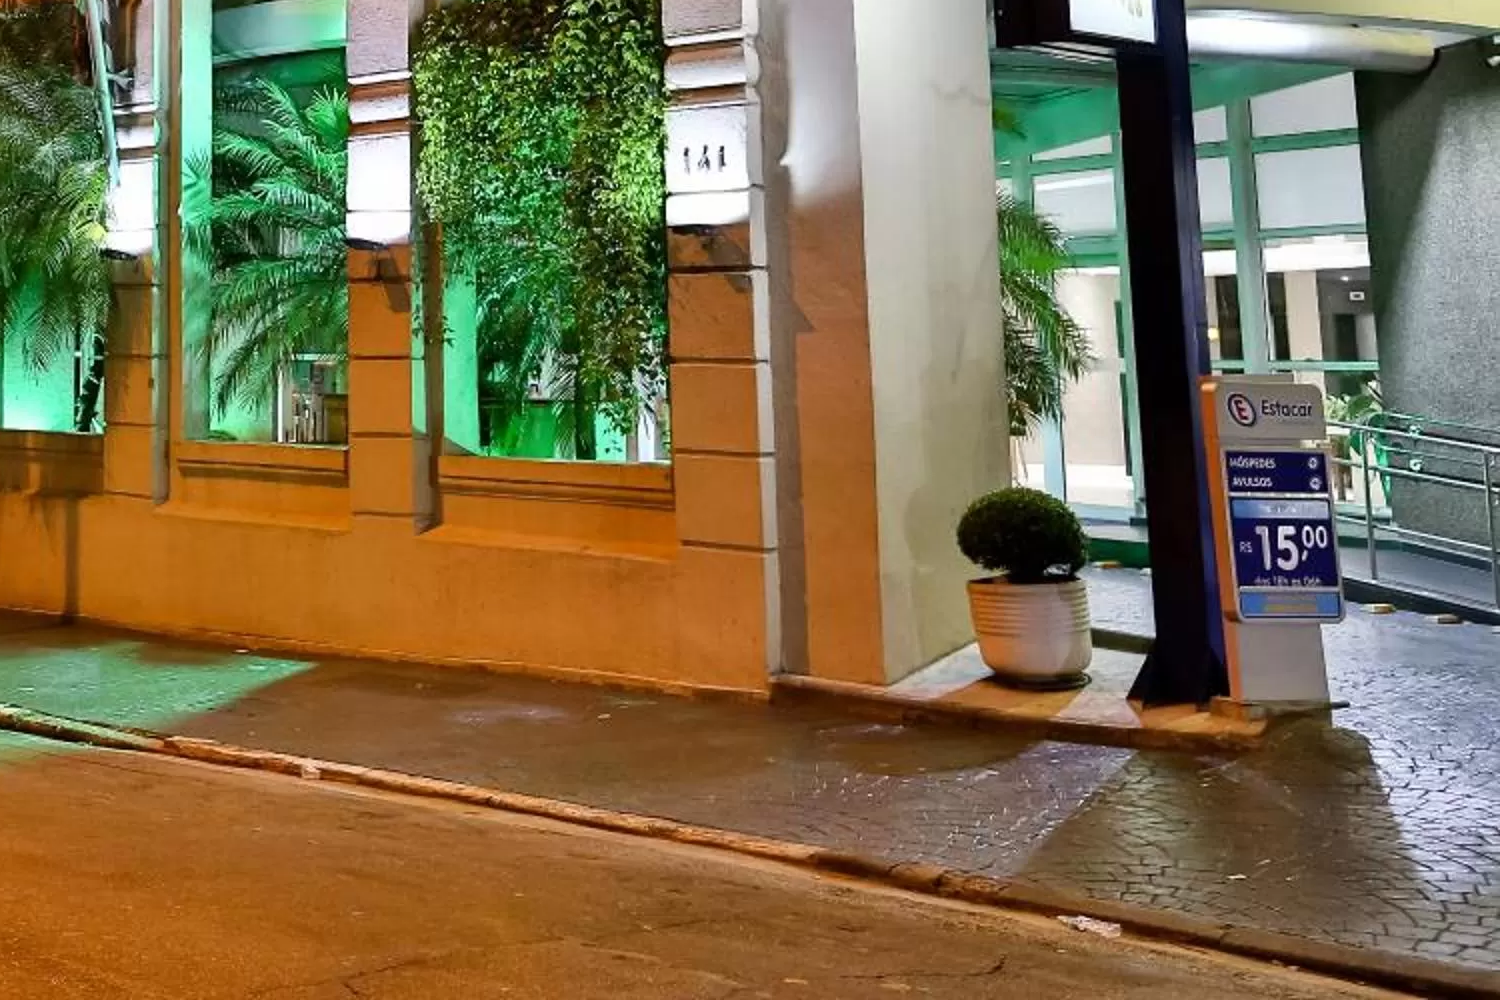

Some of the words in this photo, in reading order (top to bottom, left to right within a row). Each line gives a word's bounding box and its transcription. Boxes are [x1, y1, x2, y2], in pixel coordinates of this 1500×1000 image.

[1261, 399, 1313, 418] Estacar
[1229, 455, 1276, 469] HÓSPEDES
[1232, 476, 1273, 487] AVULSOS
[1239, 541, 1253, 553] R$
[1255, 525, 1328, 571] 15,00
